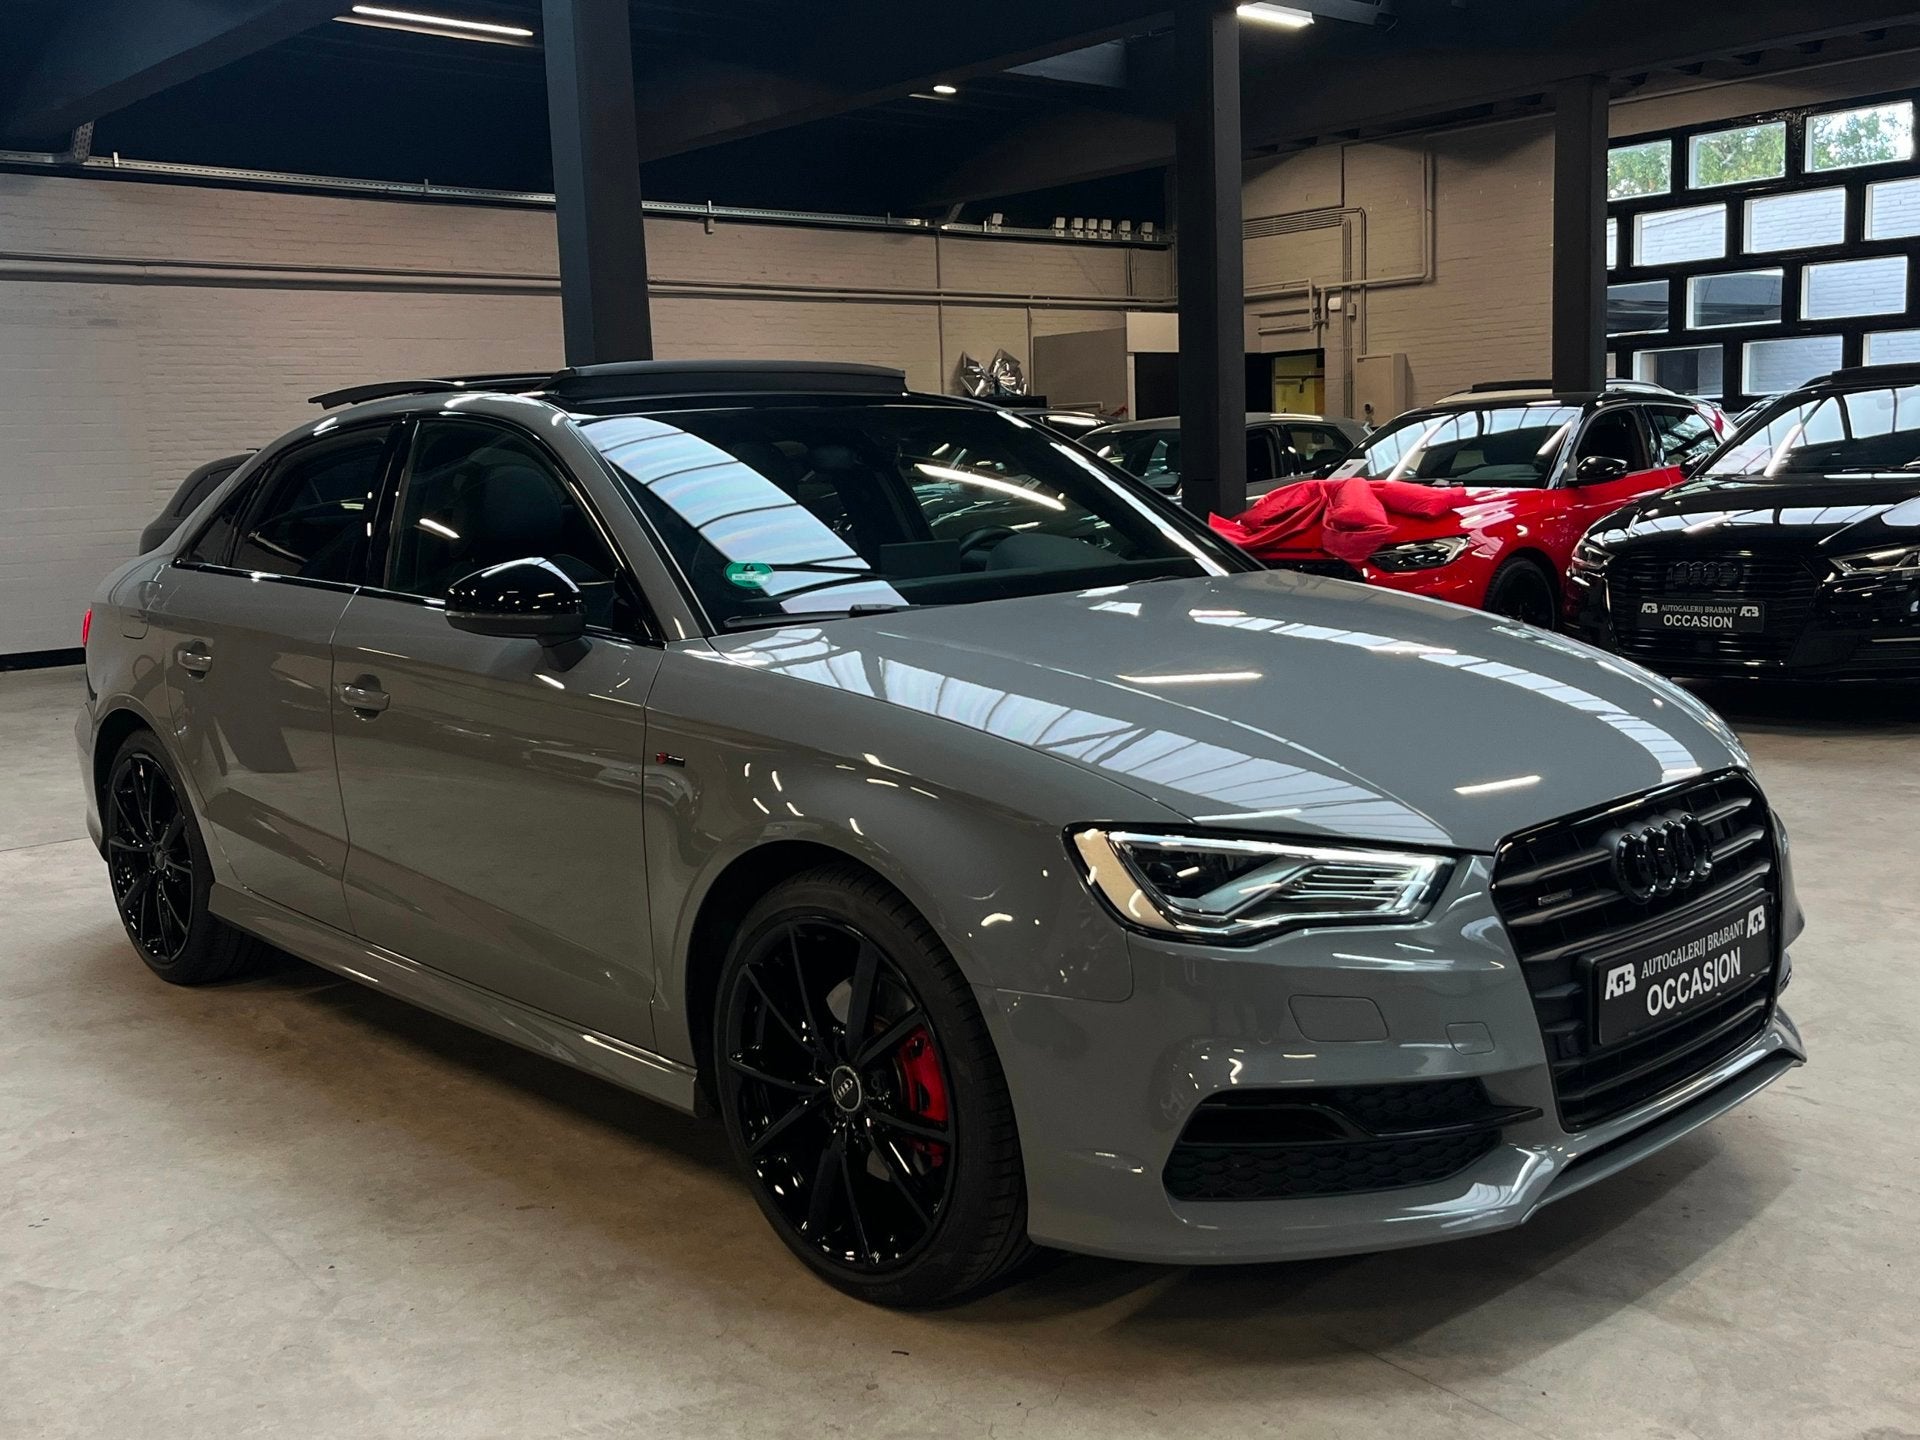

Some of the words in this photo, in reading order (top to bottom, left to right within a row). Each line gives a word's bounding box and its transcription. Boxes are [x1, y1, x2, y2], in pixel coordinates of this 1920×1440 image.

[1661, 604, 1704, 613] AUTOGALERIJ
[1705, 606, 1738, 614] BRABANT
[1663, 614, 1733, 629] OCCASION
[1641, 938, 1707, 979] AUTOGALERIJ
[1707, 918, 1745, 952] BRABANT
[1646, 946, 1742, 1016] OCCASION
